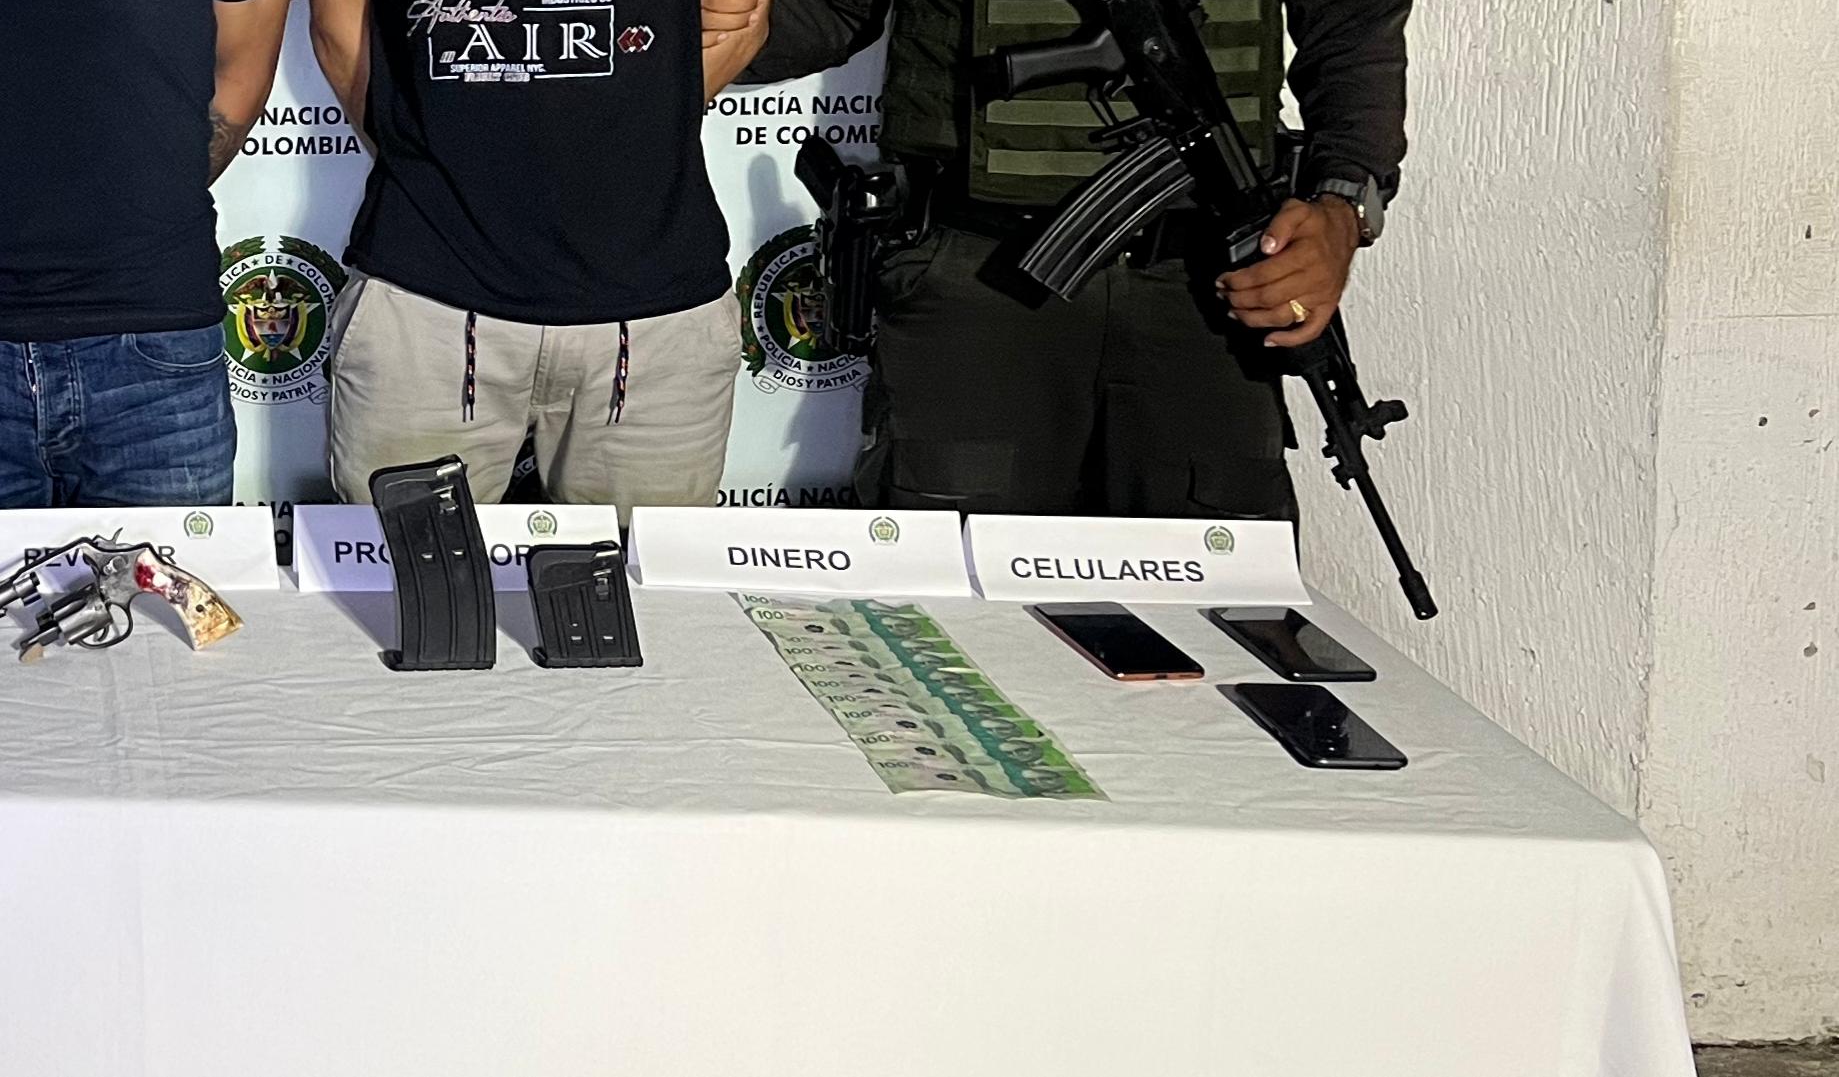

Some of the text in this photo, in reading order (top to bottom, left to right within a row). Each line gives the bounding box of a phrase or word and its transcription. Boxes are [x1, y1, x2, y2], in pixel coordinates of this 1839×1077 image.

[457, 23, 608, 61] AIR
[704, 91, 802, 116] POLICÍA
[260, 106, 352, 126] NACIO
[736, 126, 766, 146] DE
[242, 137, 360, 156] OLOMBIA
[265, 255, 283, 265] DE
[817, 369, 862, 388] PATRIA
[272, 381, 317, 401] PATRIA
[727, 545, 852, 571] DINERO
[1010, 556, 1205, 583] CELULARES
